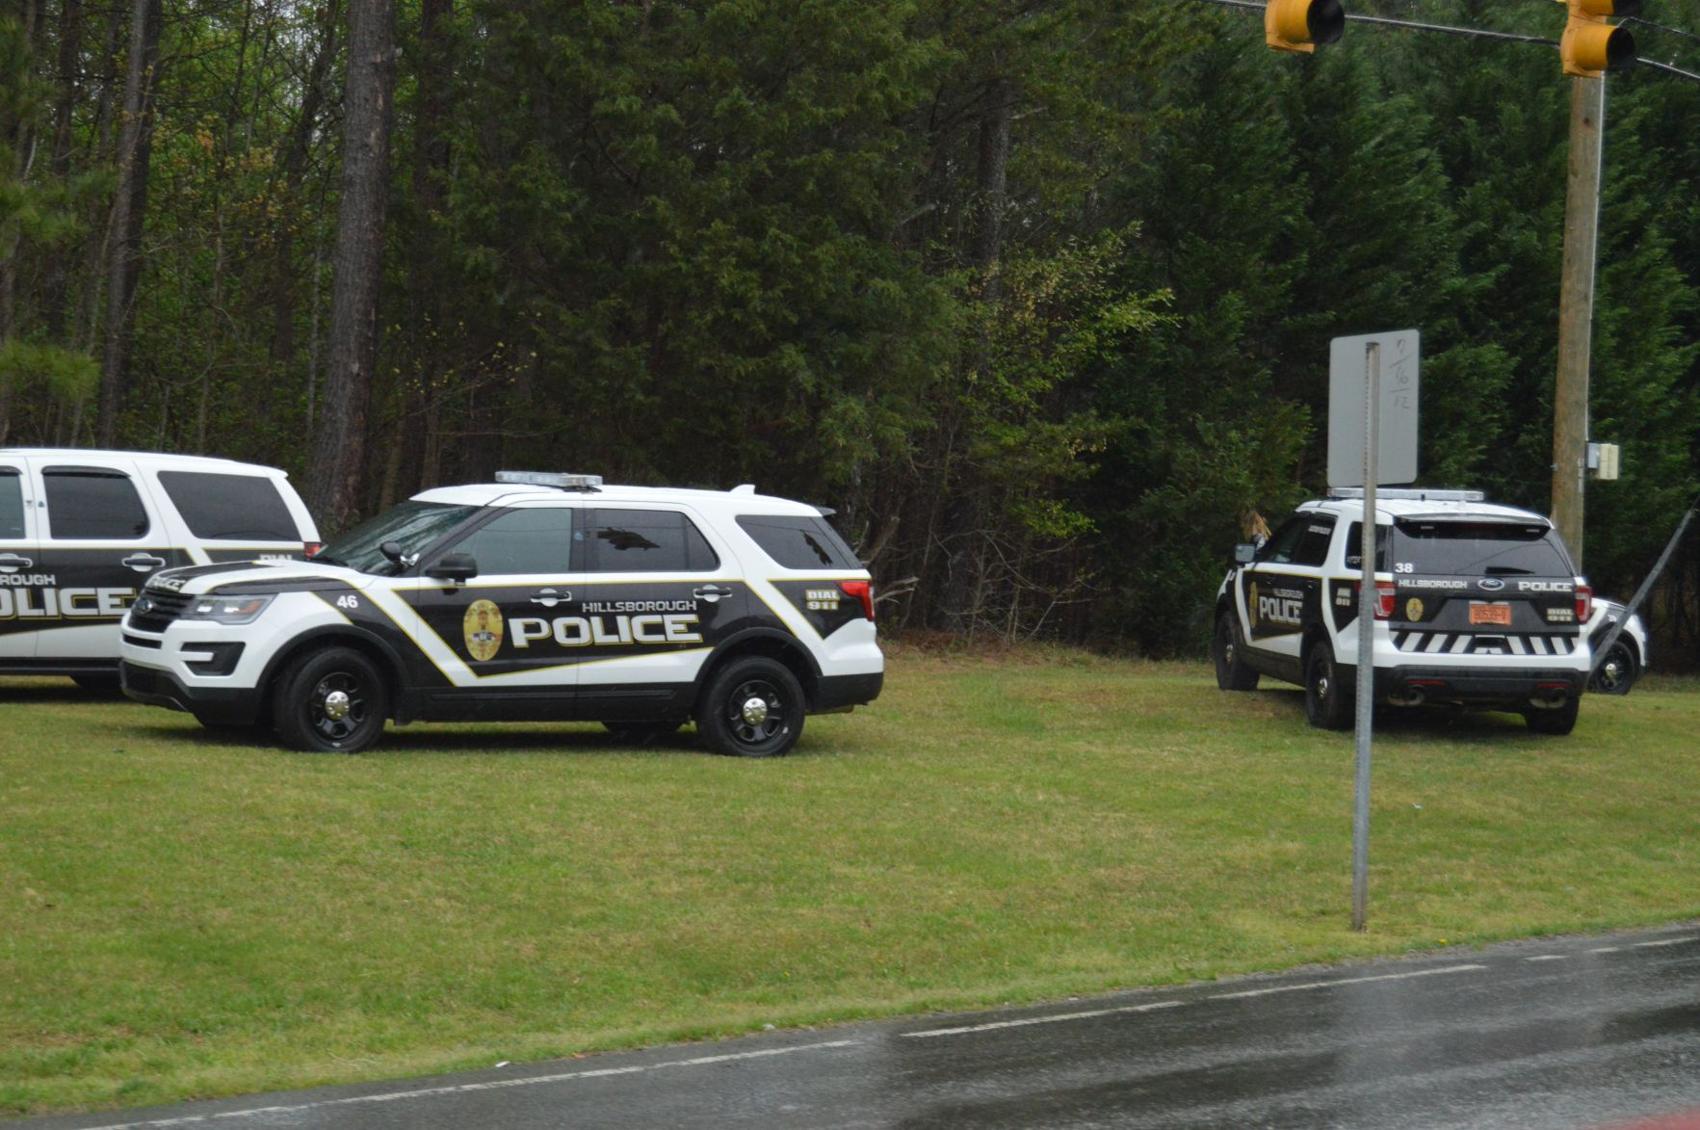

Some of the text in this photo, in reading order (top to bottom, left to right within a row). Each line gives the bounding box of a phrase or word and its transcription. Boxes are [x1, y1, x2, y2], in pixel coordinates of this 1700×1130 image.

[1395, 562, 1413, 573] 38
[1398, 580, 1572, 592] HILLSBOROUGH POLICE
[806, 590, 839, 600] DIAL
[337, 595, 358, 608] 46
[582, 600, 697, 612] HILLSBOROUGH
[807, 601, 838, 610] 911
[1259, 596, 1303, 624] POLICE
[508, 614, 704, 648] POLICE
